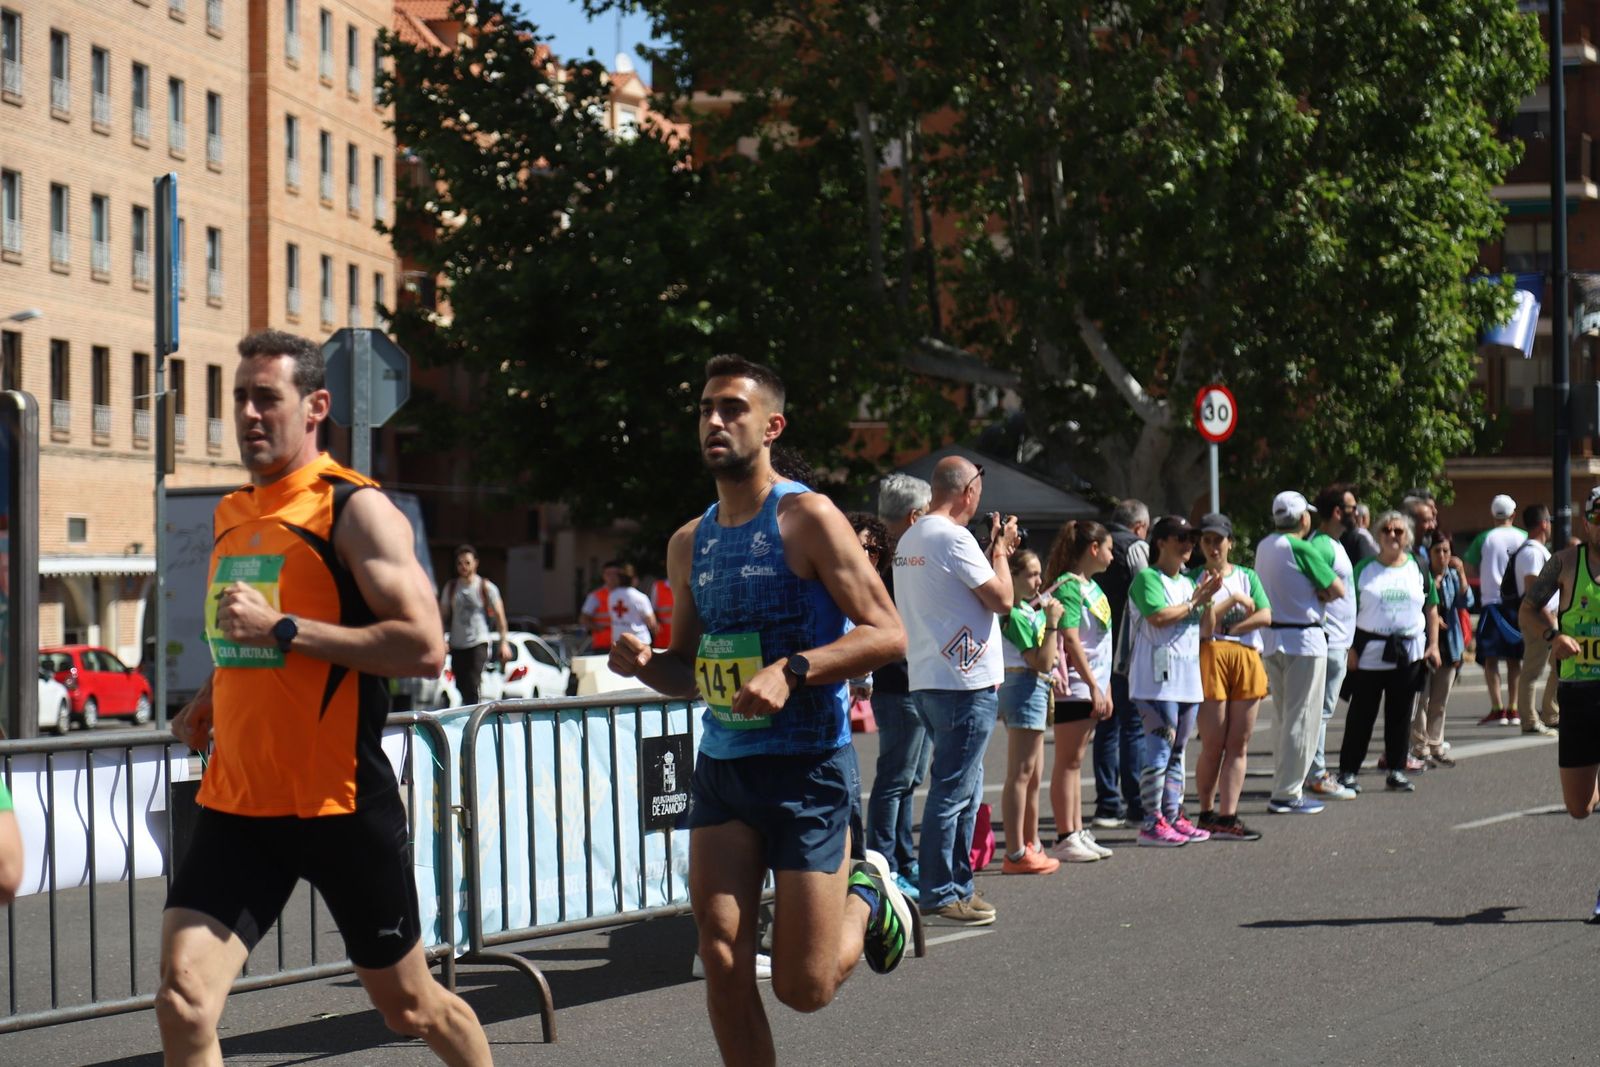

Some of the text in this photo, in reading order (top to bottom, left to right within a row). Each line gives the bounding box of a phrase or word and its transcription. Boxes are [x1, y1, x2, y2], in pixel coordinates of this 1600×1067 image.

[1204, 403, 1229, 421] 30
[240, 647, 278, 659] RURAL
[699, 663, 742, 698] 141
[652, 793, 688, 805] AYUNTAMIENTO
[652, 801, 687, 816] DE ZAMORA
